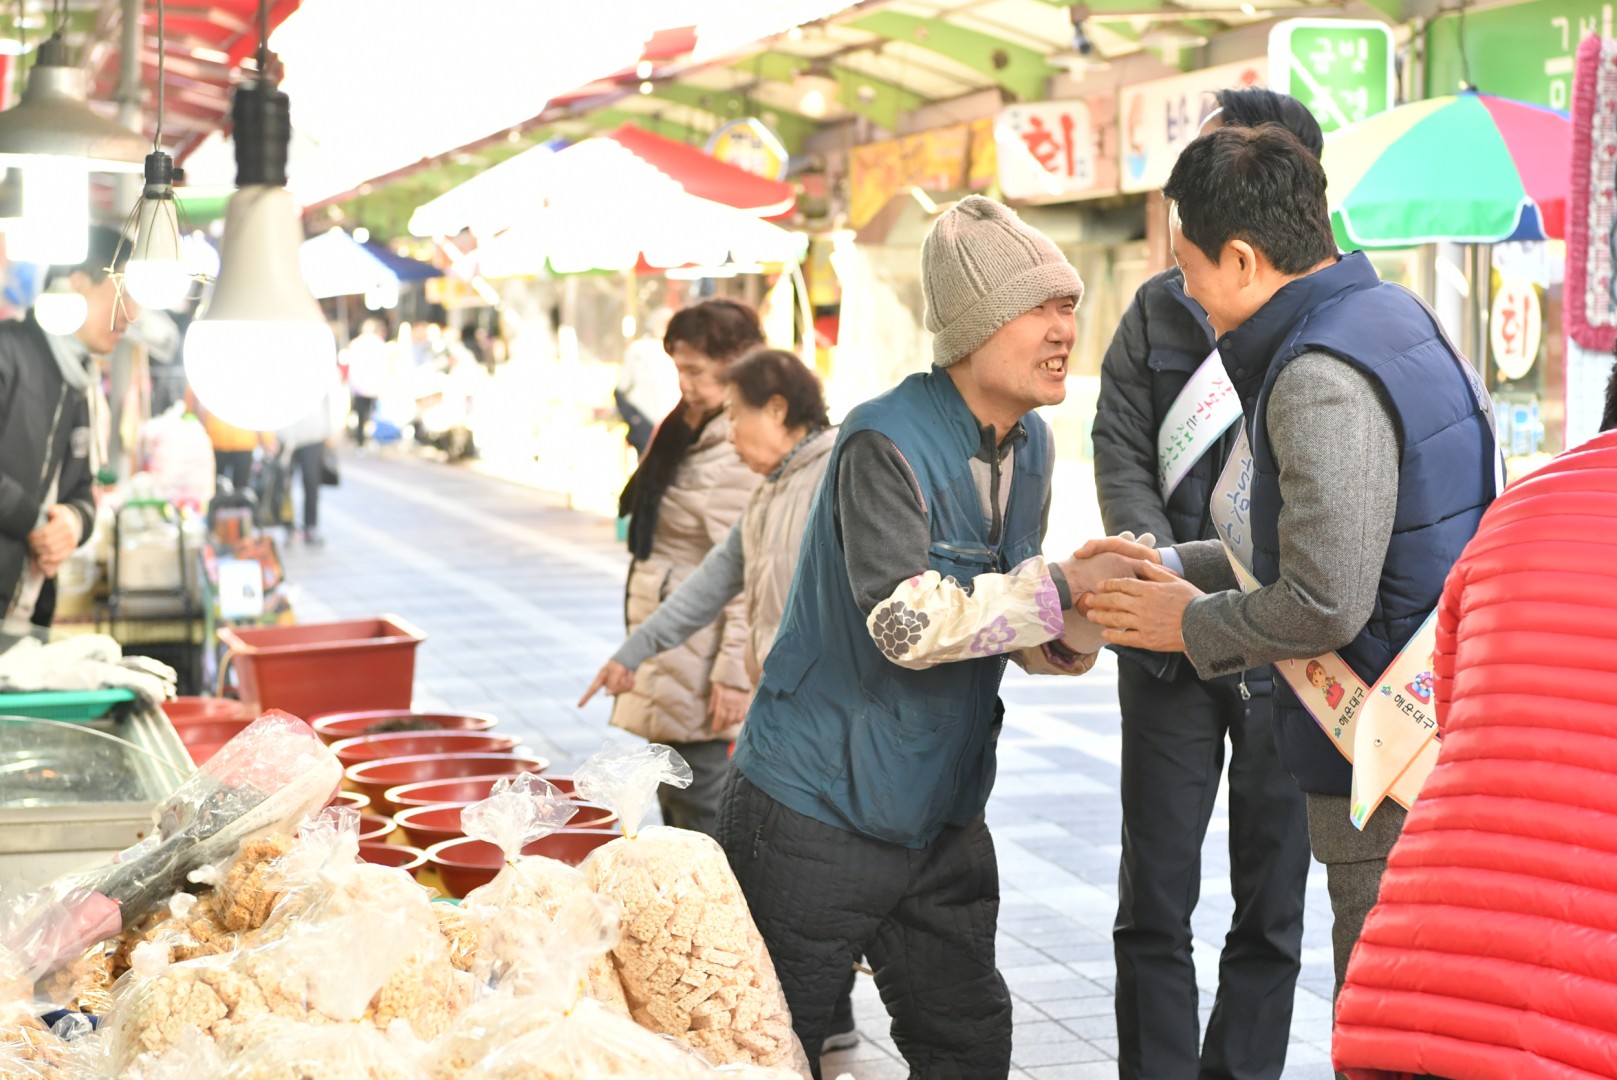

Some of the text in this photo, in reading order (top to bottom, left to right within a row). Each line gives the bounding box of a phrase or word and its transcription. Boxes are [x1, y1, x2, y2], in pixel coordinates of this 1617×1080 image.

[1020, 114, 1074, 177] 회
[1501, 294, 1530, 358] 회
[1339, 687, 1366, 726] 해운대구
[1394, 694, 1435, 729] 해운대구
